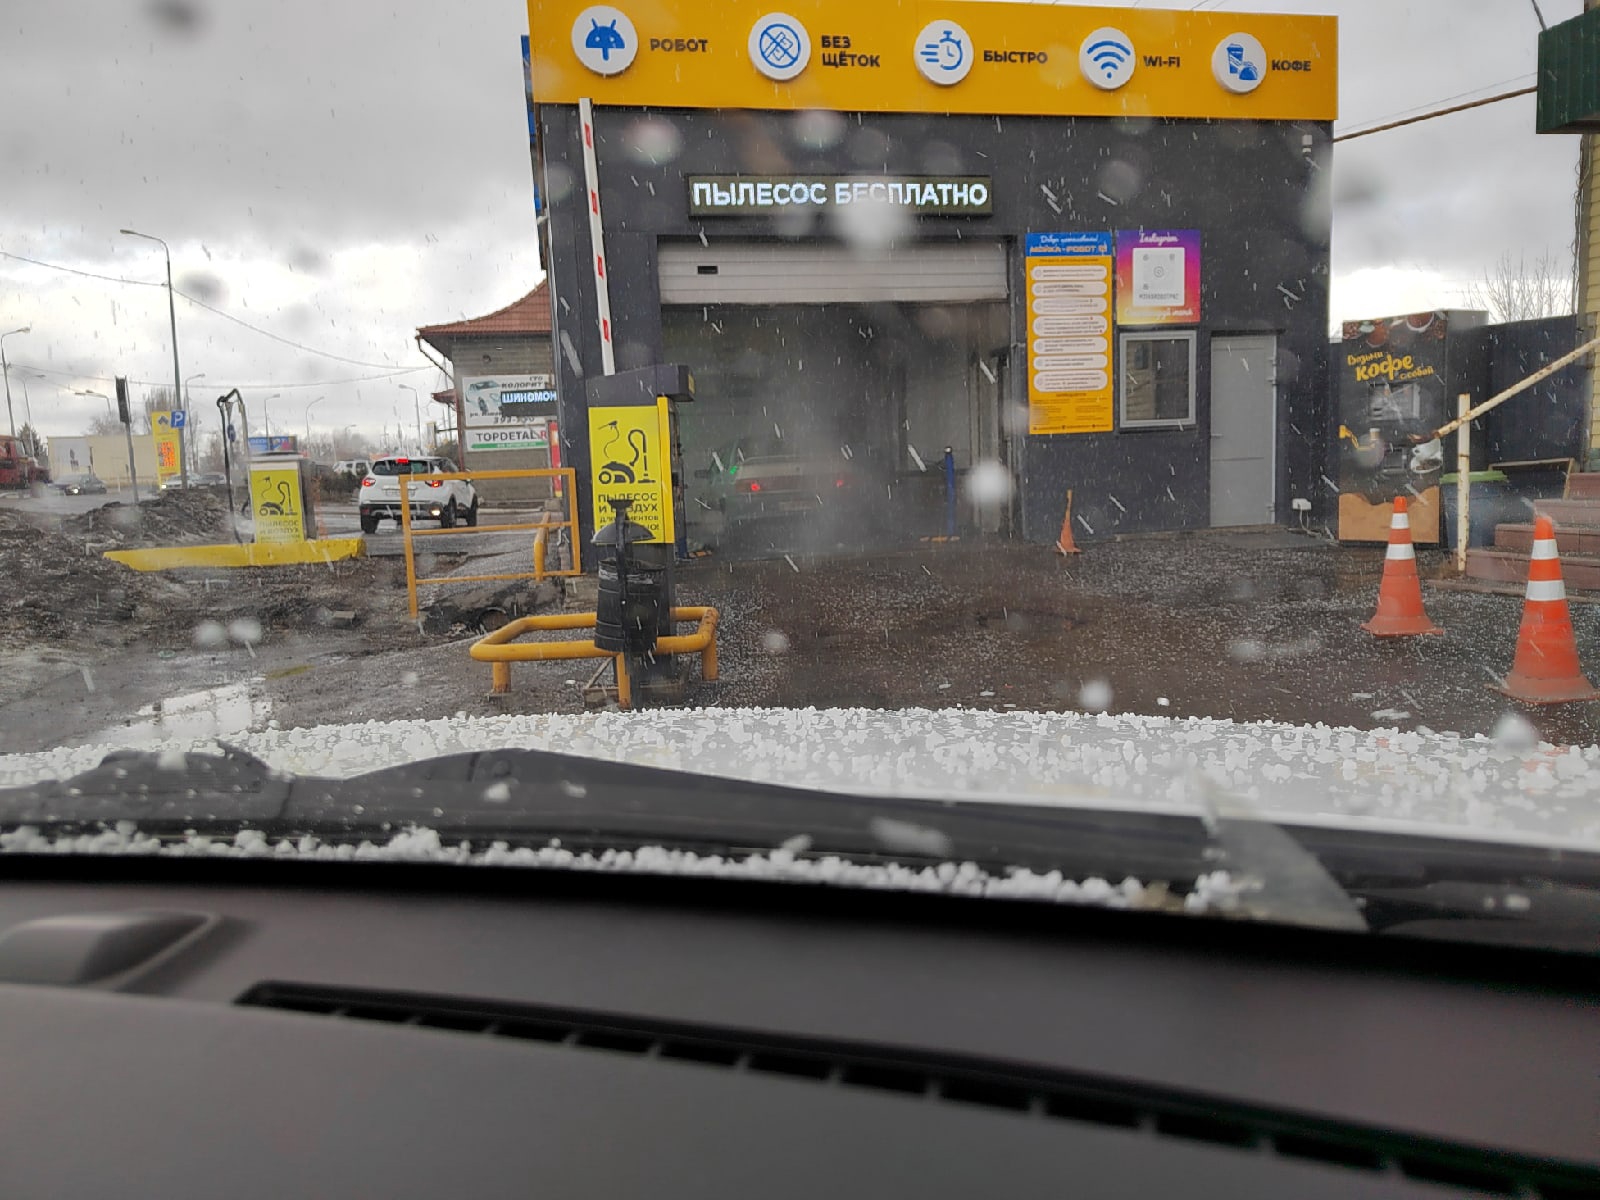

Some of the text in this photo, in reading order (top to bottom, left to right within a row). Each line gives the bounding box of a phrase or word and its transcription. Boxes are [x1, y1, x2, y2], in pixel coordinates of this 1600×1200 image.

[650, 38, 708, 53] РОБОТ
[821, 35, 851, 49] БЕЗ
[822, 53, 881, 68] ЩЁТОК
[983, 50, 1049, 64] БЫСТРО
[1143, 55, 1181, 69] WI-FI
[1271, 59, 1312, 72] КОФЕ
[692, 182, 990, 206] ПЫЛЕСОС БЕСПЛАТНО
[598, 504, 607, 514] И
